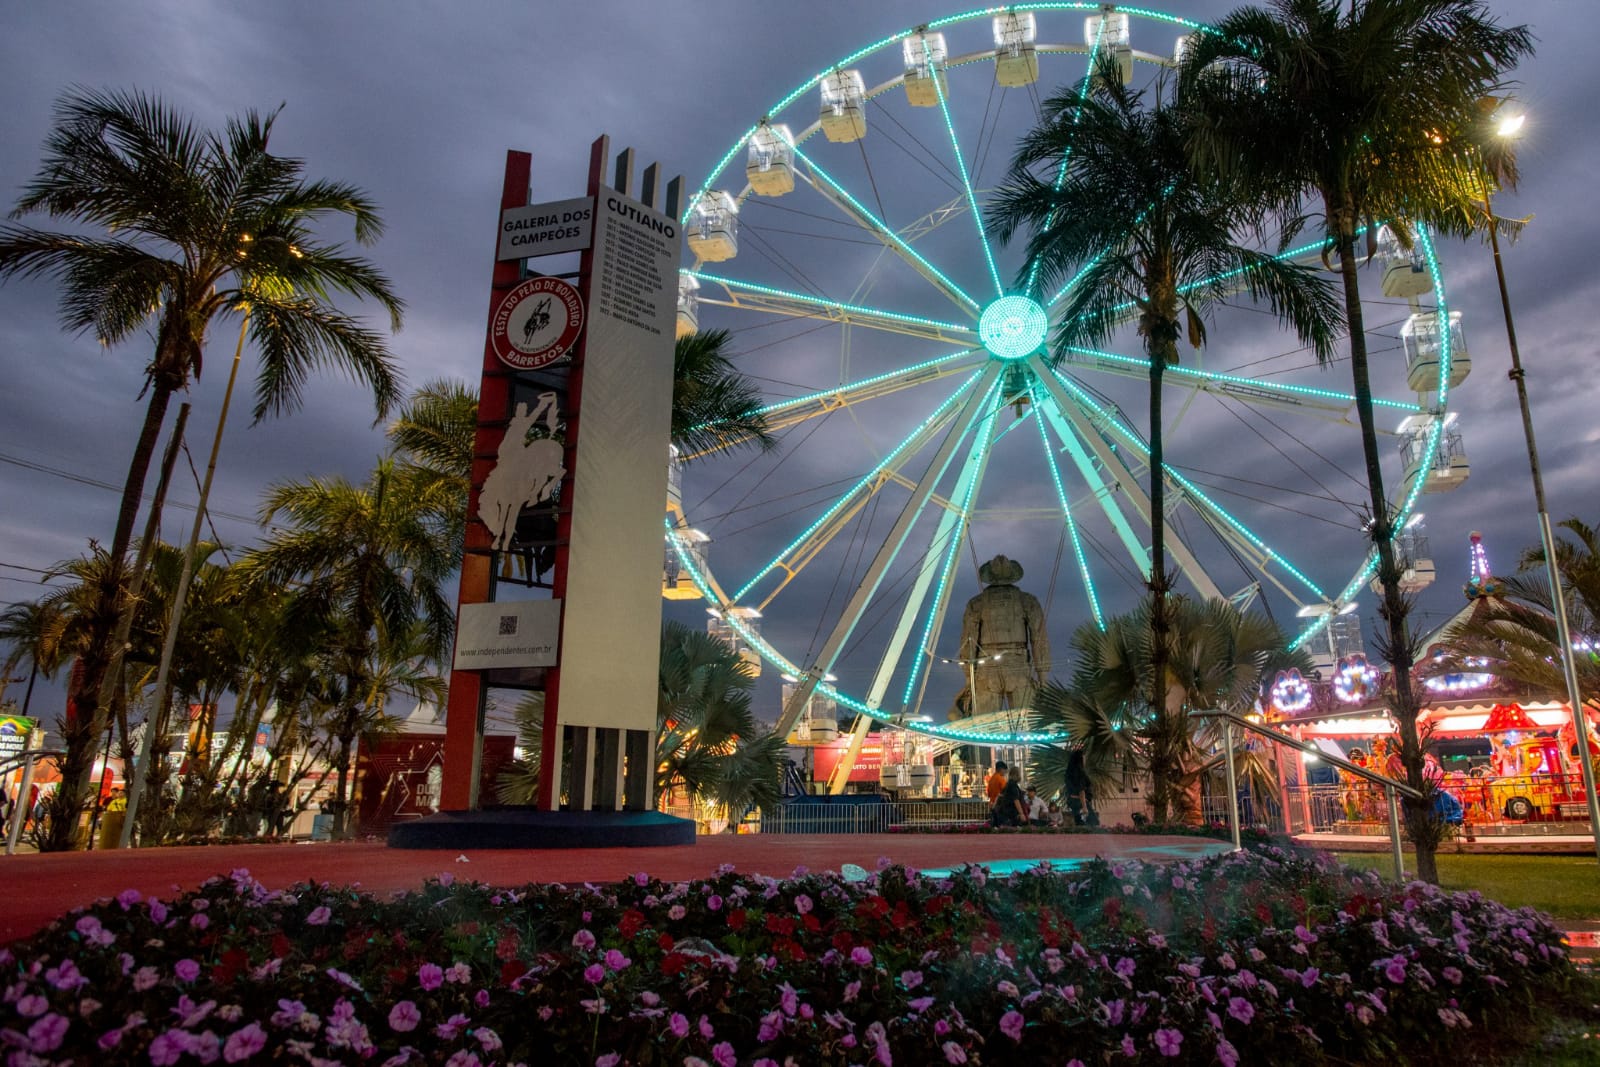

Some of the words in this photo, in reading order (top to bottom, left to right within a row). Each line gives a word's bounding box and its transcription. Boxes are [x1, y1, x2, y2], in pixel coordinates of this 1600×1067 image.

[504, 213, 558, 232] GALERIA
[562, 209, 590, 223] DOS
[608, 198, 674, 238] CUTIANO
[511, 227, 580, 246] CAMPEÕES
[496, 308, 508, 337] FESTA
[506, 296, 517, 310] DO
[519, 281, 542, 298] PEÃO
[543, 280, 554, 290] DE
[556, 284, 579, 327] BOIADEIRO
[506, 344, 563, 366] BARRETOS
[461, 646, 552, 656] www.independentes.com.br
